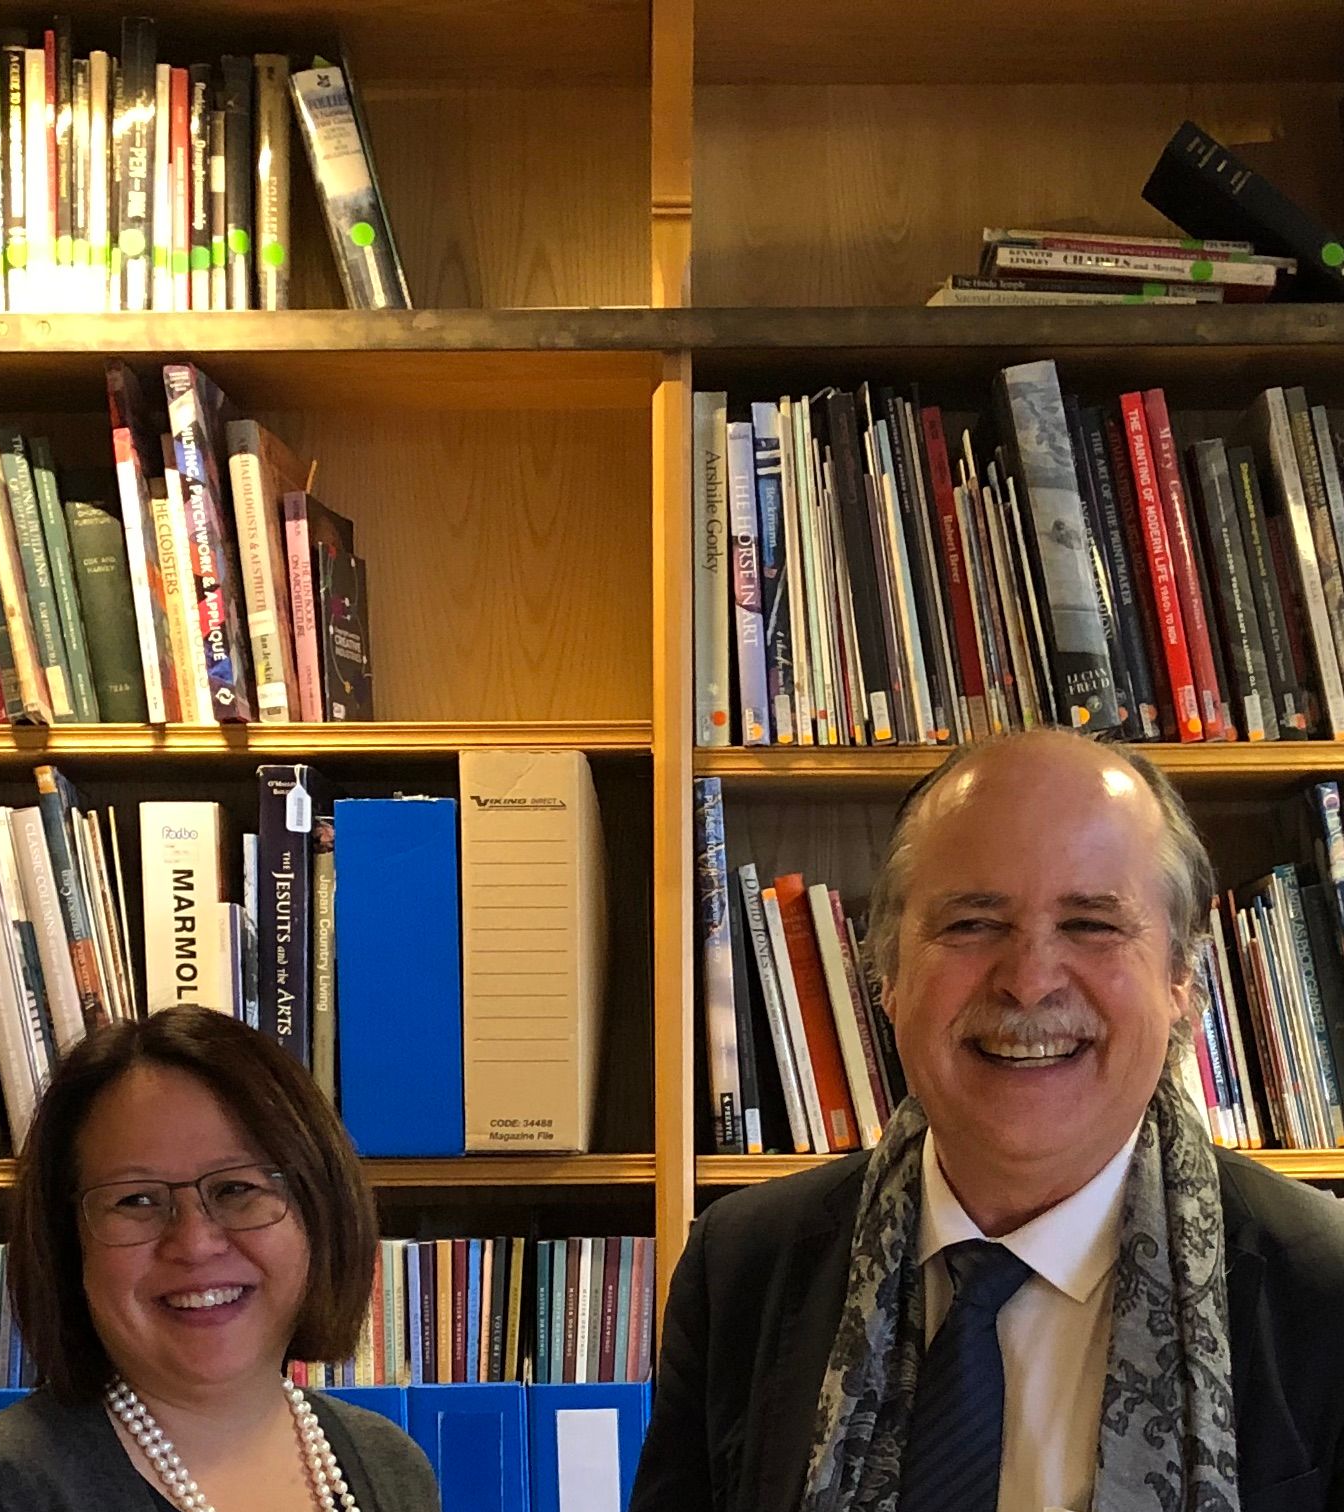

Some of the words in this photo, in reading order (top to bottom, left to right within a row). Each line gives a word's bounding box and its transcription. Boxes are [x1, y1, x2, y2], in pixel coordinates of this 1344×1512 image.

[1125, 408, 1140, 433] THE
[702, 449, 723, 514] Arshile
[1129, 439, 1150, 487] PAINTING
[735, 473, 752, 509] THE
[1138, 488, 1152, 503] OF
[189, 484, 215, 574] PATCHWORK
[202, 576, 216, 588] &
[765, 486, 778, 548] Beckmann
[1141, 505, 1161, 554] MODERN
[155, 527, 179, 596] CLOISTERS
[701, 518, 723, 574] Gorky
[736, 514, 754, 578] HORSE
[1106, 529, 1130, 606] PRINTMAKER
[1152, 557, 1167, 584] LIFE
[739, 583, 757, 607] IN
[741, 611, 758, 647] ART
[1068, 679, 1111, 695] FREUD
[469, 795, 526, 808] VIKING
[24, 822, 43, 873] CLASSIC
[281, 851, 292, 870] THE
[271, 871, 296, 943] JESUITS
[317, 874, 331, 914] Japan
[171, 868, 199, 1004] MARMOL
[316, 918, 331, 971] Country
[276, 988, 296, 1036] ARTS
[316, 975, 331, 1012] Living
[488, 1130, 535, 1142] Magazine
[536, 1130, 554, 1141] File
